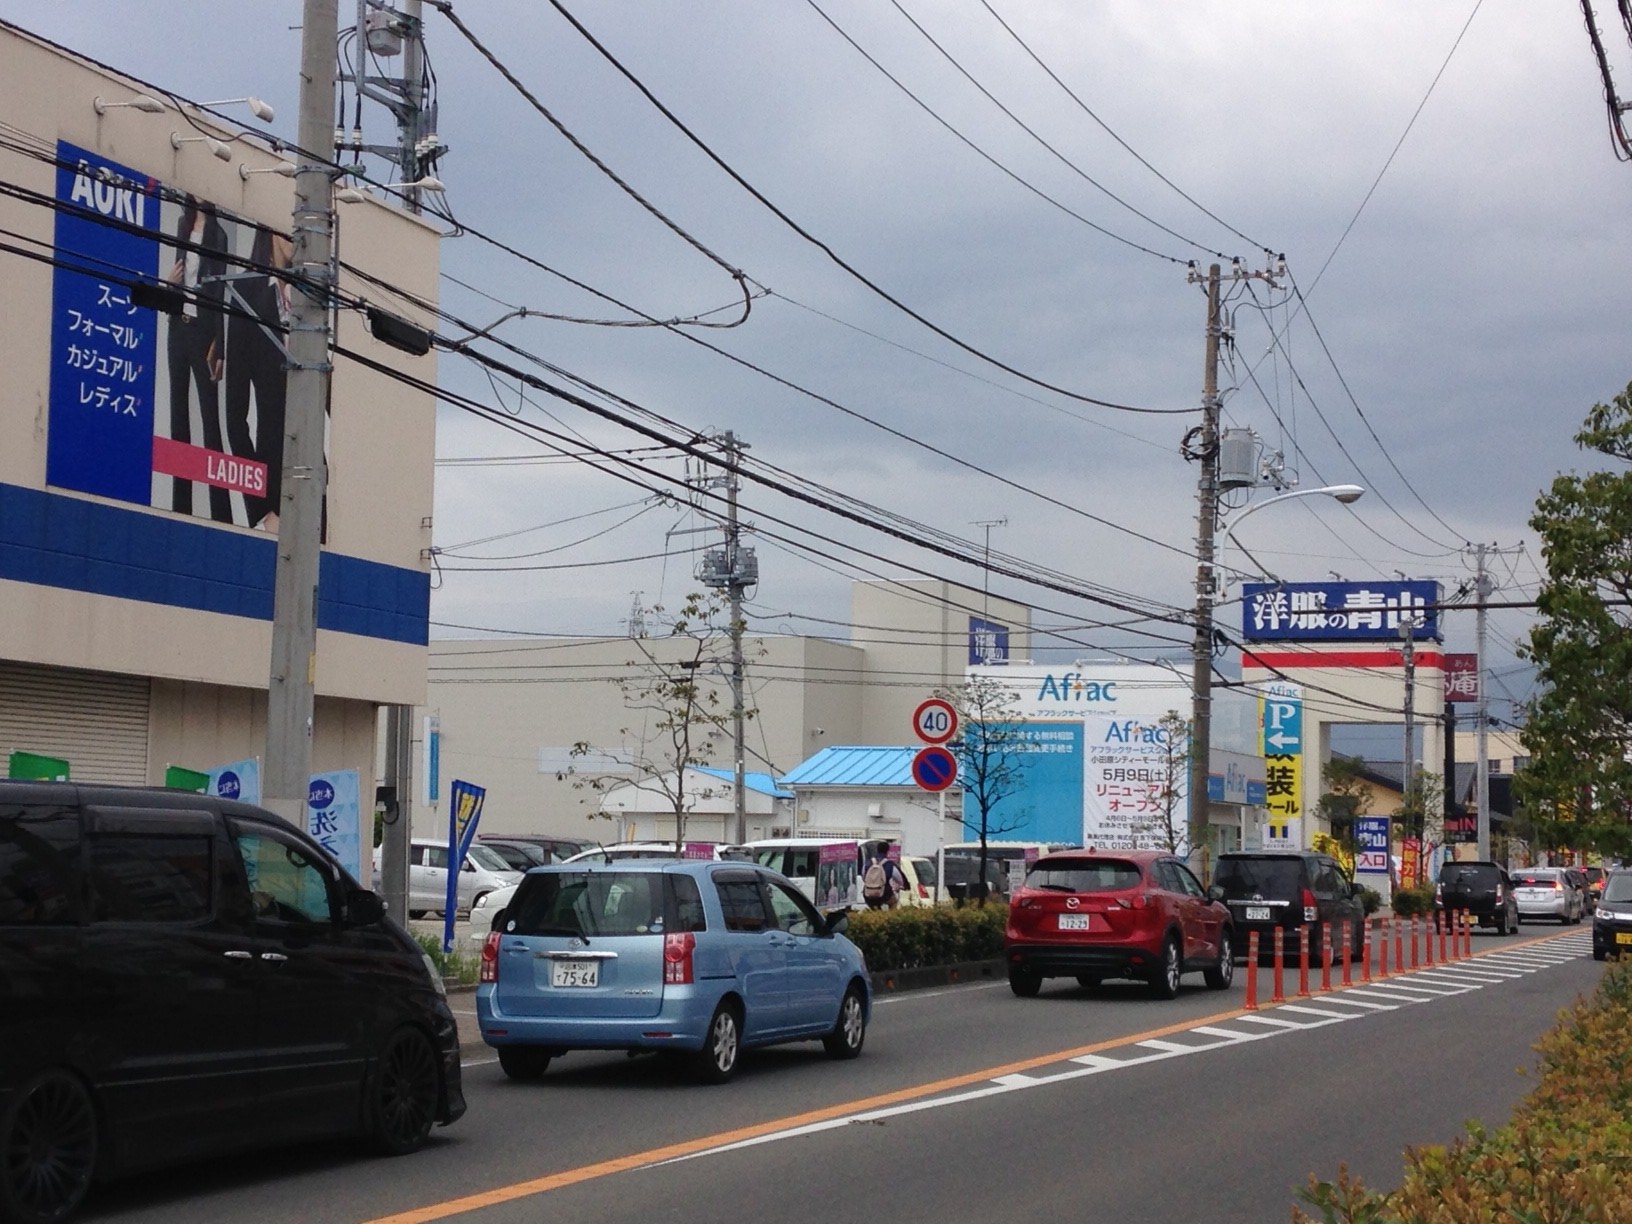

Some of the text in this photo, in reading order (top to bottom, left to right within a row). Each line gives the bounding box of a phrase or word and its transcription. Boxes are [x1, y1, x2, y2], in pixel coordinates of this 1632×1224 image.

[70, 158, 145, 228] AOKI
[67, 309, 138, 350] フォーマル
[66, 343, 138, 383] カジュアル
[80, 381, 137, 417] レディス
[207, 455, 263, 491] LADIES
[1252, 590, 1425, 630] 洋服の青山
[1037, 672, 1118, 702] Aflac
[923, 712, 948, 731] 40
[1269, 703, 1296, 729] P
[1104, 720, 1167, 743] Aflac
[1358, 821, 1386, 831] 洋服の
[1460, 817, 1478, 831] IN
[1094, 842, 1109, 850] TEL
[1359, 854, 1386, 867] 入口
[562, 971, 596, 986] 75-64
